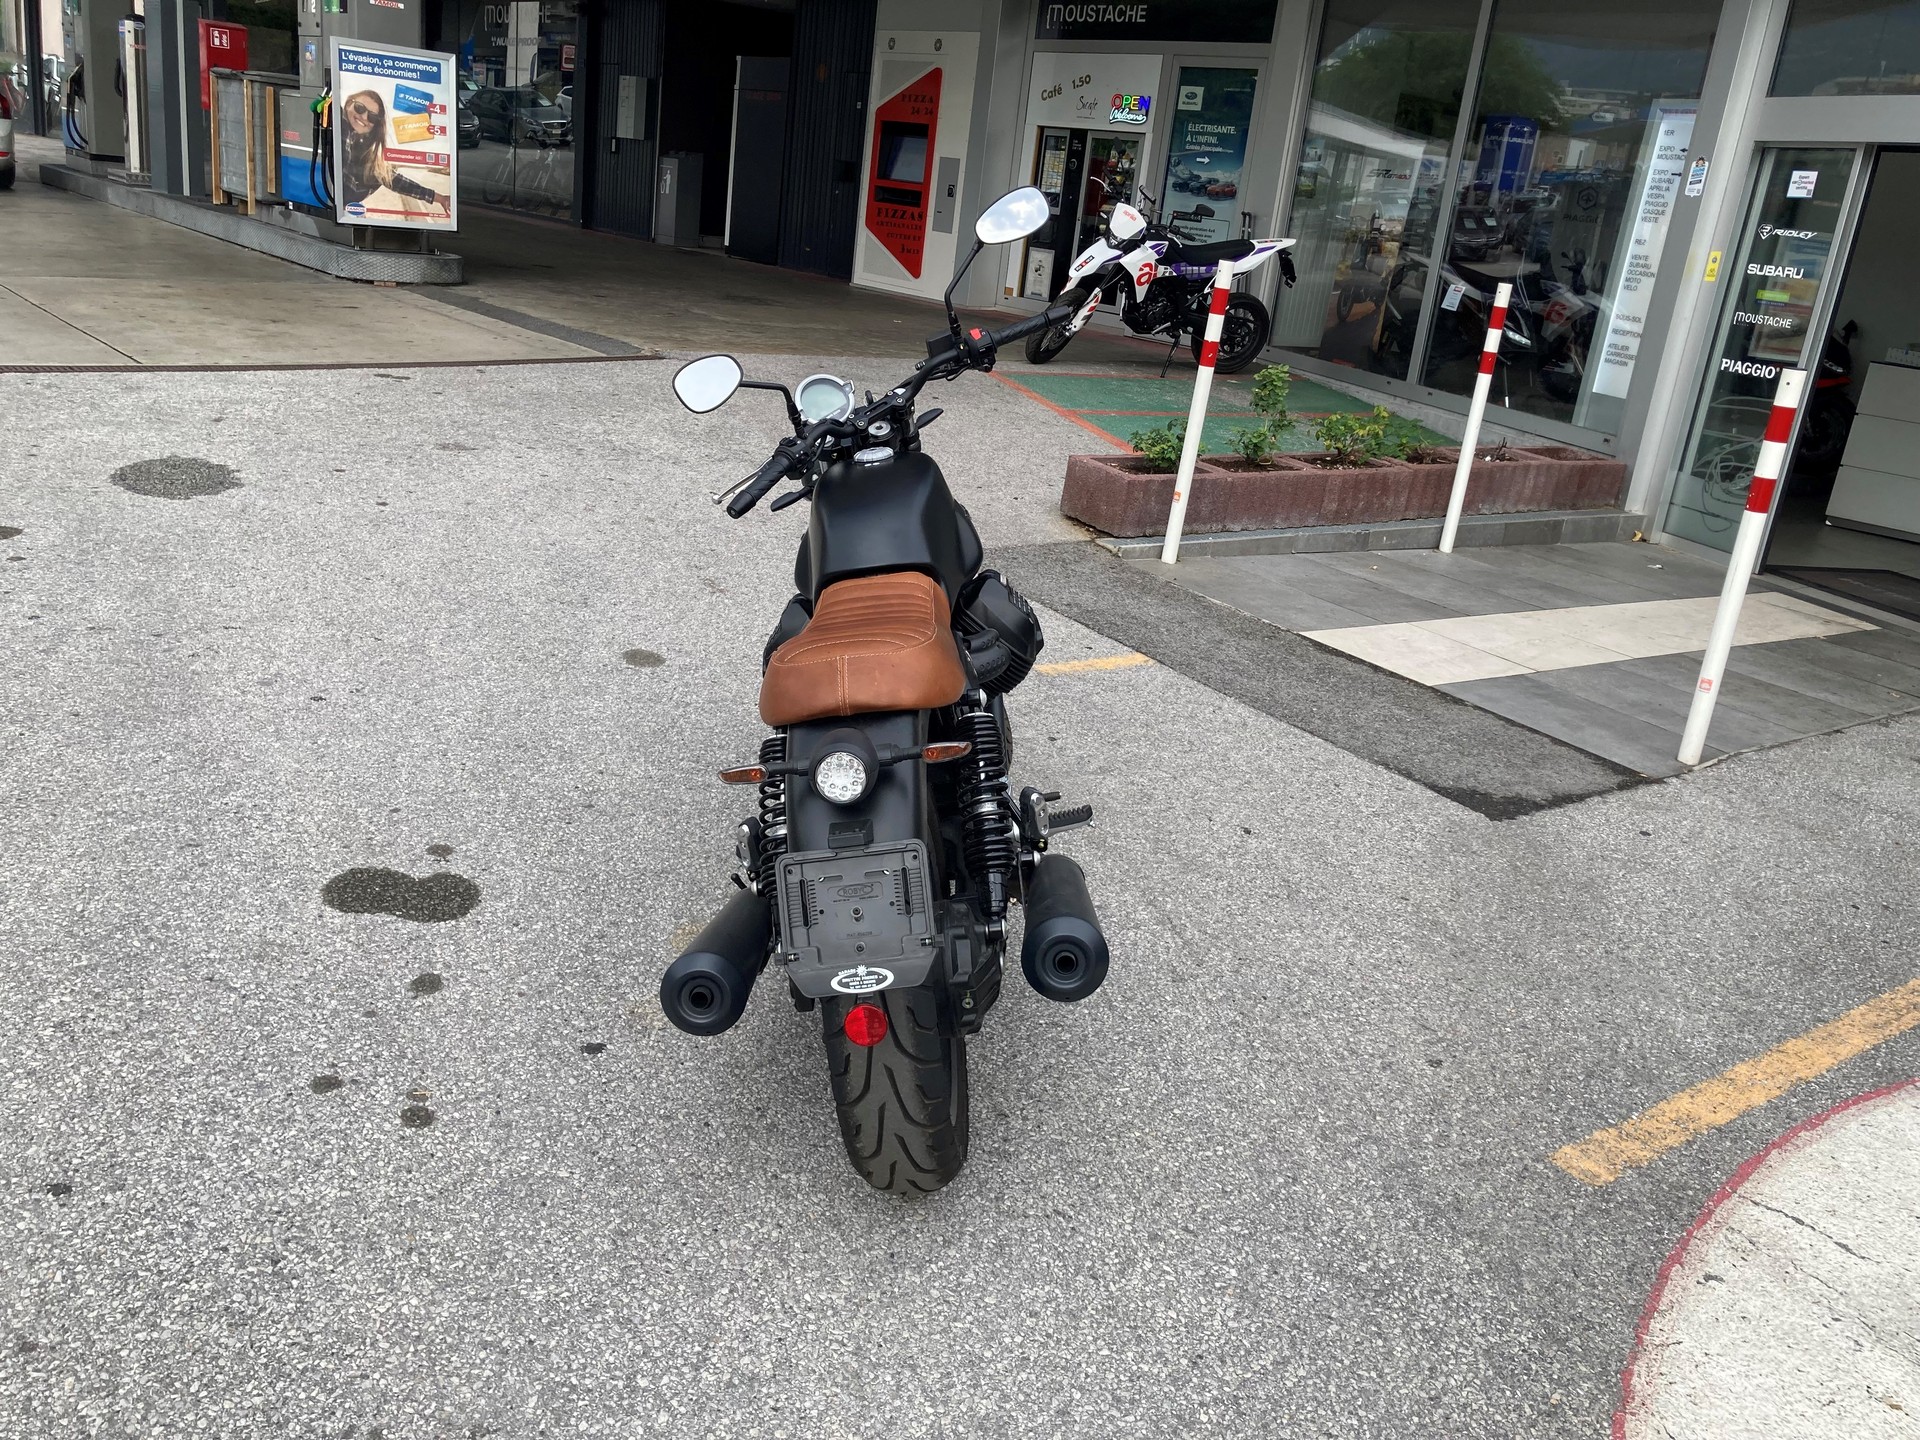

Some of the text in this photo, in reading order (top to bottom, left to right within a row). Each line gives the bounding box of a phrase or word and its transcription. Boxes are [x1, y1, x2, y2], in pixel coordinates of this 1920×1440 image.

[1046, 4, 1148, 29] MOUSTACHE
[341, 51, 438, 72] L'évasion, ça commence
[342, 62, 356, 71] par
[357, 62, 373, 72] des
[1071, 74, 1092, 90] 1.50
[1041, 83, 1063, 101] Café
[901, 93, 934, 104] PIZZA
[1110, 93, 1152, 111] OPEN
[1187, 121, 1237, 134] ÉLECTRISANTE.
[1185, 132, 1219, 144] À L'INFINI.
[1646, 192, 1666, 200] VESPA
[1644, 200, 1669, 208] PIAGGIO
[876, 207, 924, 222] PIZZAS
[1122, 209, 1137, 222] aprilia
[1642, 208, 1667, 216] CASQUE
[1772, 229, 1818, 240] RIDLEY
[1631, 254, 1649, 262] VENTE
[1628, 261, 1652, 270] SUBARU
[1746, 263, 1804, 279] SUBARU
[1626, 269, 1656, 278] OCCASION
[1624, 276, 1642, 285] MOTO
[1623, 284, 1638, 292] VELO
[1615, 313, 1643, 324] SOUS-SOL
[1733, 311, 1793, 329] MOUSTACHE
[1611, 328, 1642, 338] RECEPTION
[1608, 343, 1630, 352] ATELIER
[1604, 357, 1629, 367] MAGASIN
[1720, 358, 1776, 379] PIAGGIO
